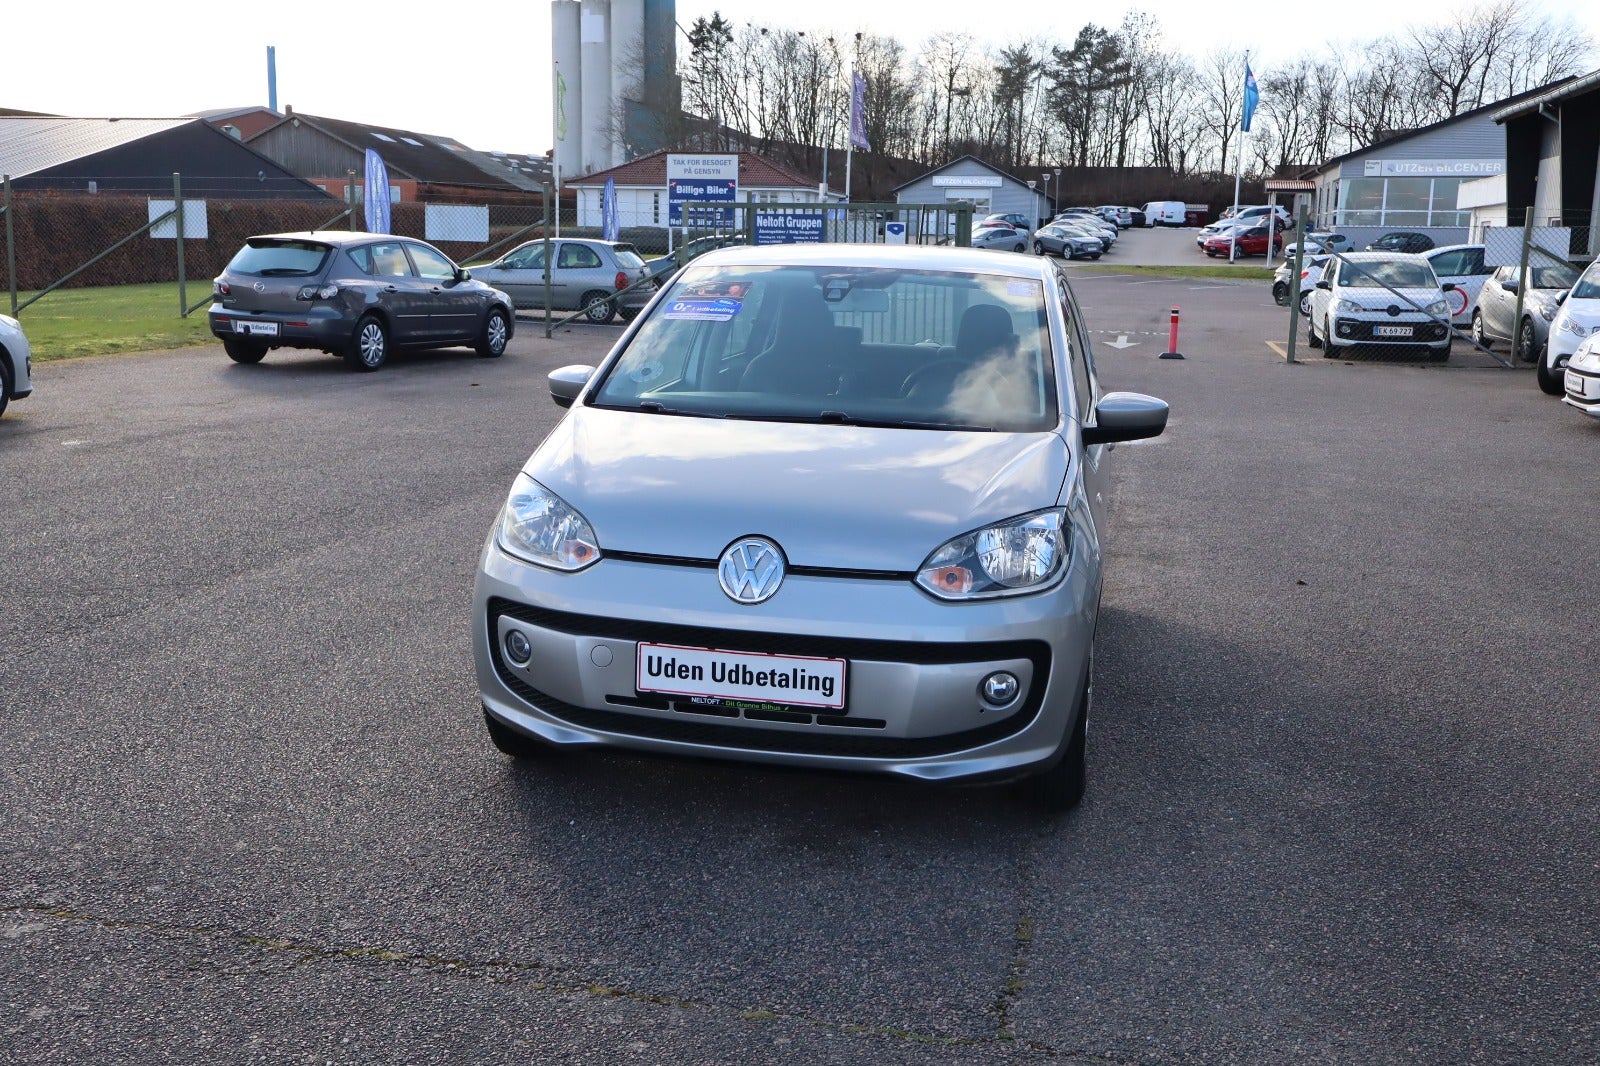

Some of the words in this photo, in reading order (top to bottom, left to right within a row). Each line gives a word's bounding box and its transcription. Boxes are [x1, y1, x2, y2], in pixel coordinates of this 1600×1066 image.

[1436, 163, 1502, 172] BILCENTER
[676, 185, 704, 195] Billige
[706, 185, 728, 194] Biler
[756, 215, 784, 227] Neltoft
[786, 216, 822, 230] Gruppen
[647, 655, 703, 681] Uden
[712, 661, 835, 697] Udbetaling
[691, 697, 720, 705] NELTOFT
